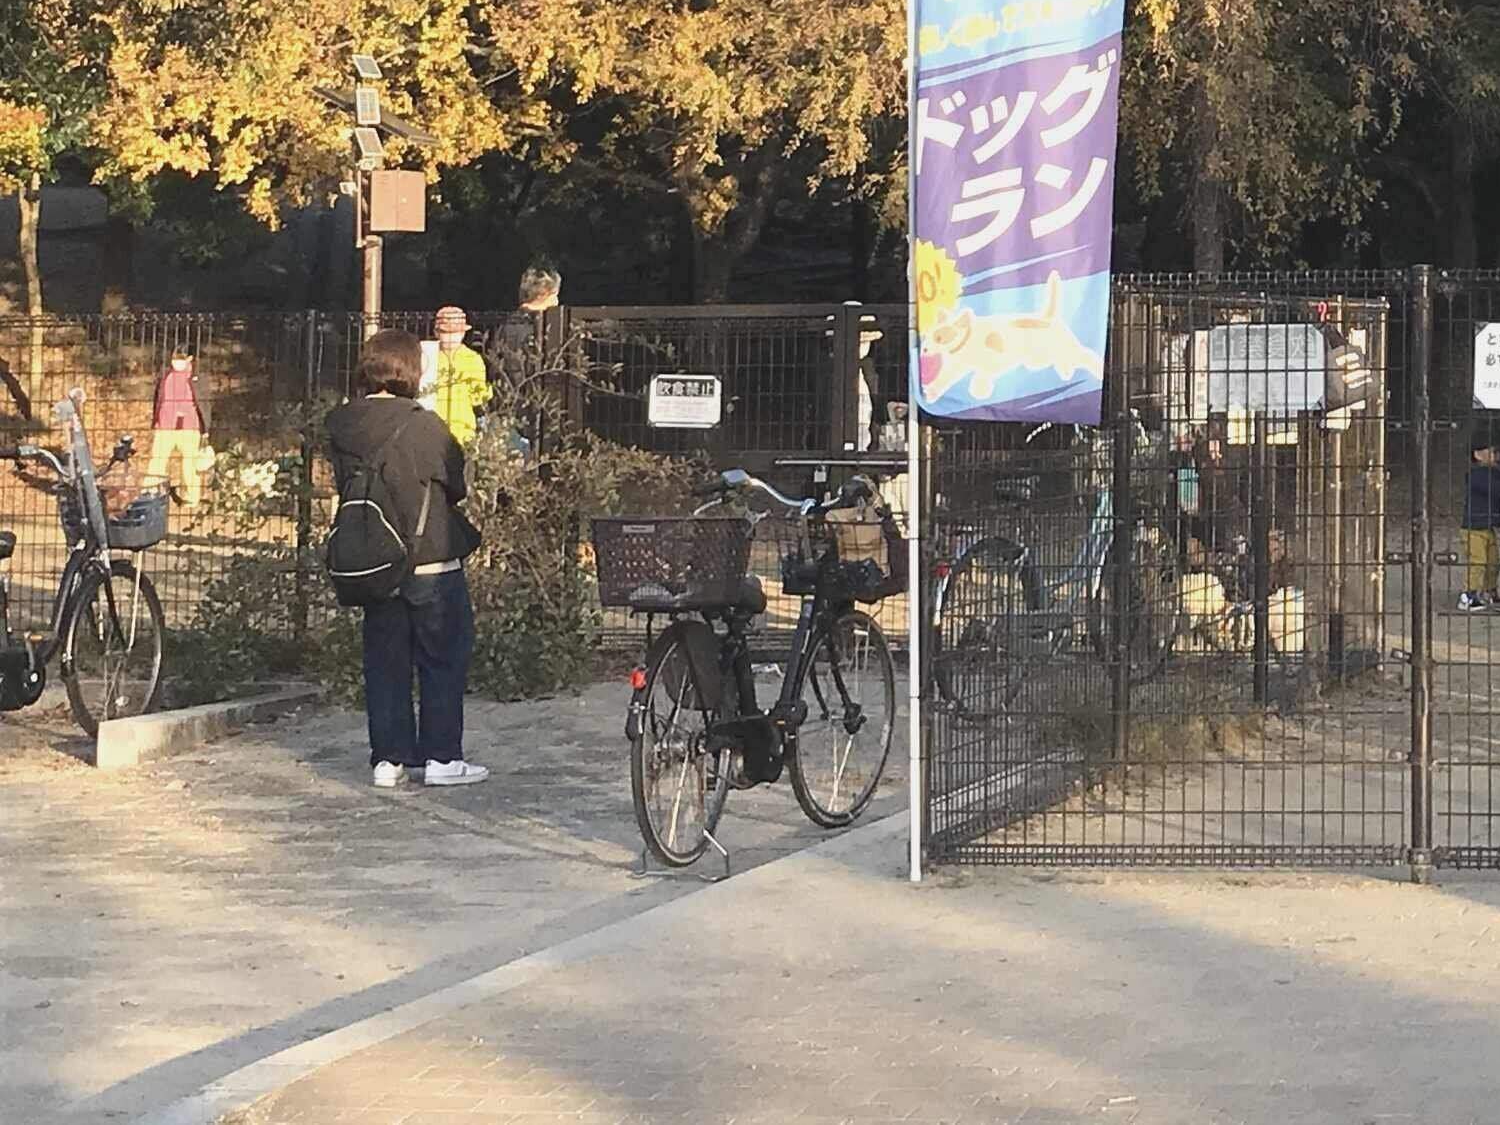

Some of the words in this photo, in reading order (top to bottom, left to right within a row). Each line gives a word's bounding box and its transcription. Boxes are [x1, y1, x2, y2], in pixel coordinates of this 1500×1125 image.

[916, 49, 1117, 175] ドッグ
[950, 156, 1108, 256] ラン
[656, 380, 714, 397] 飲食禁止
